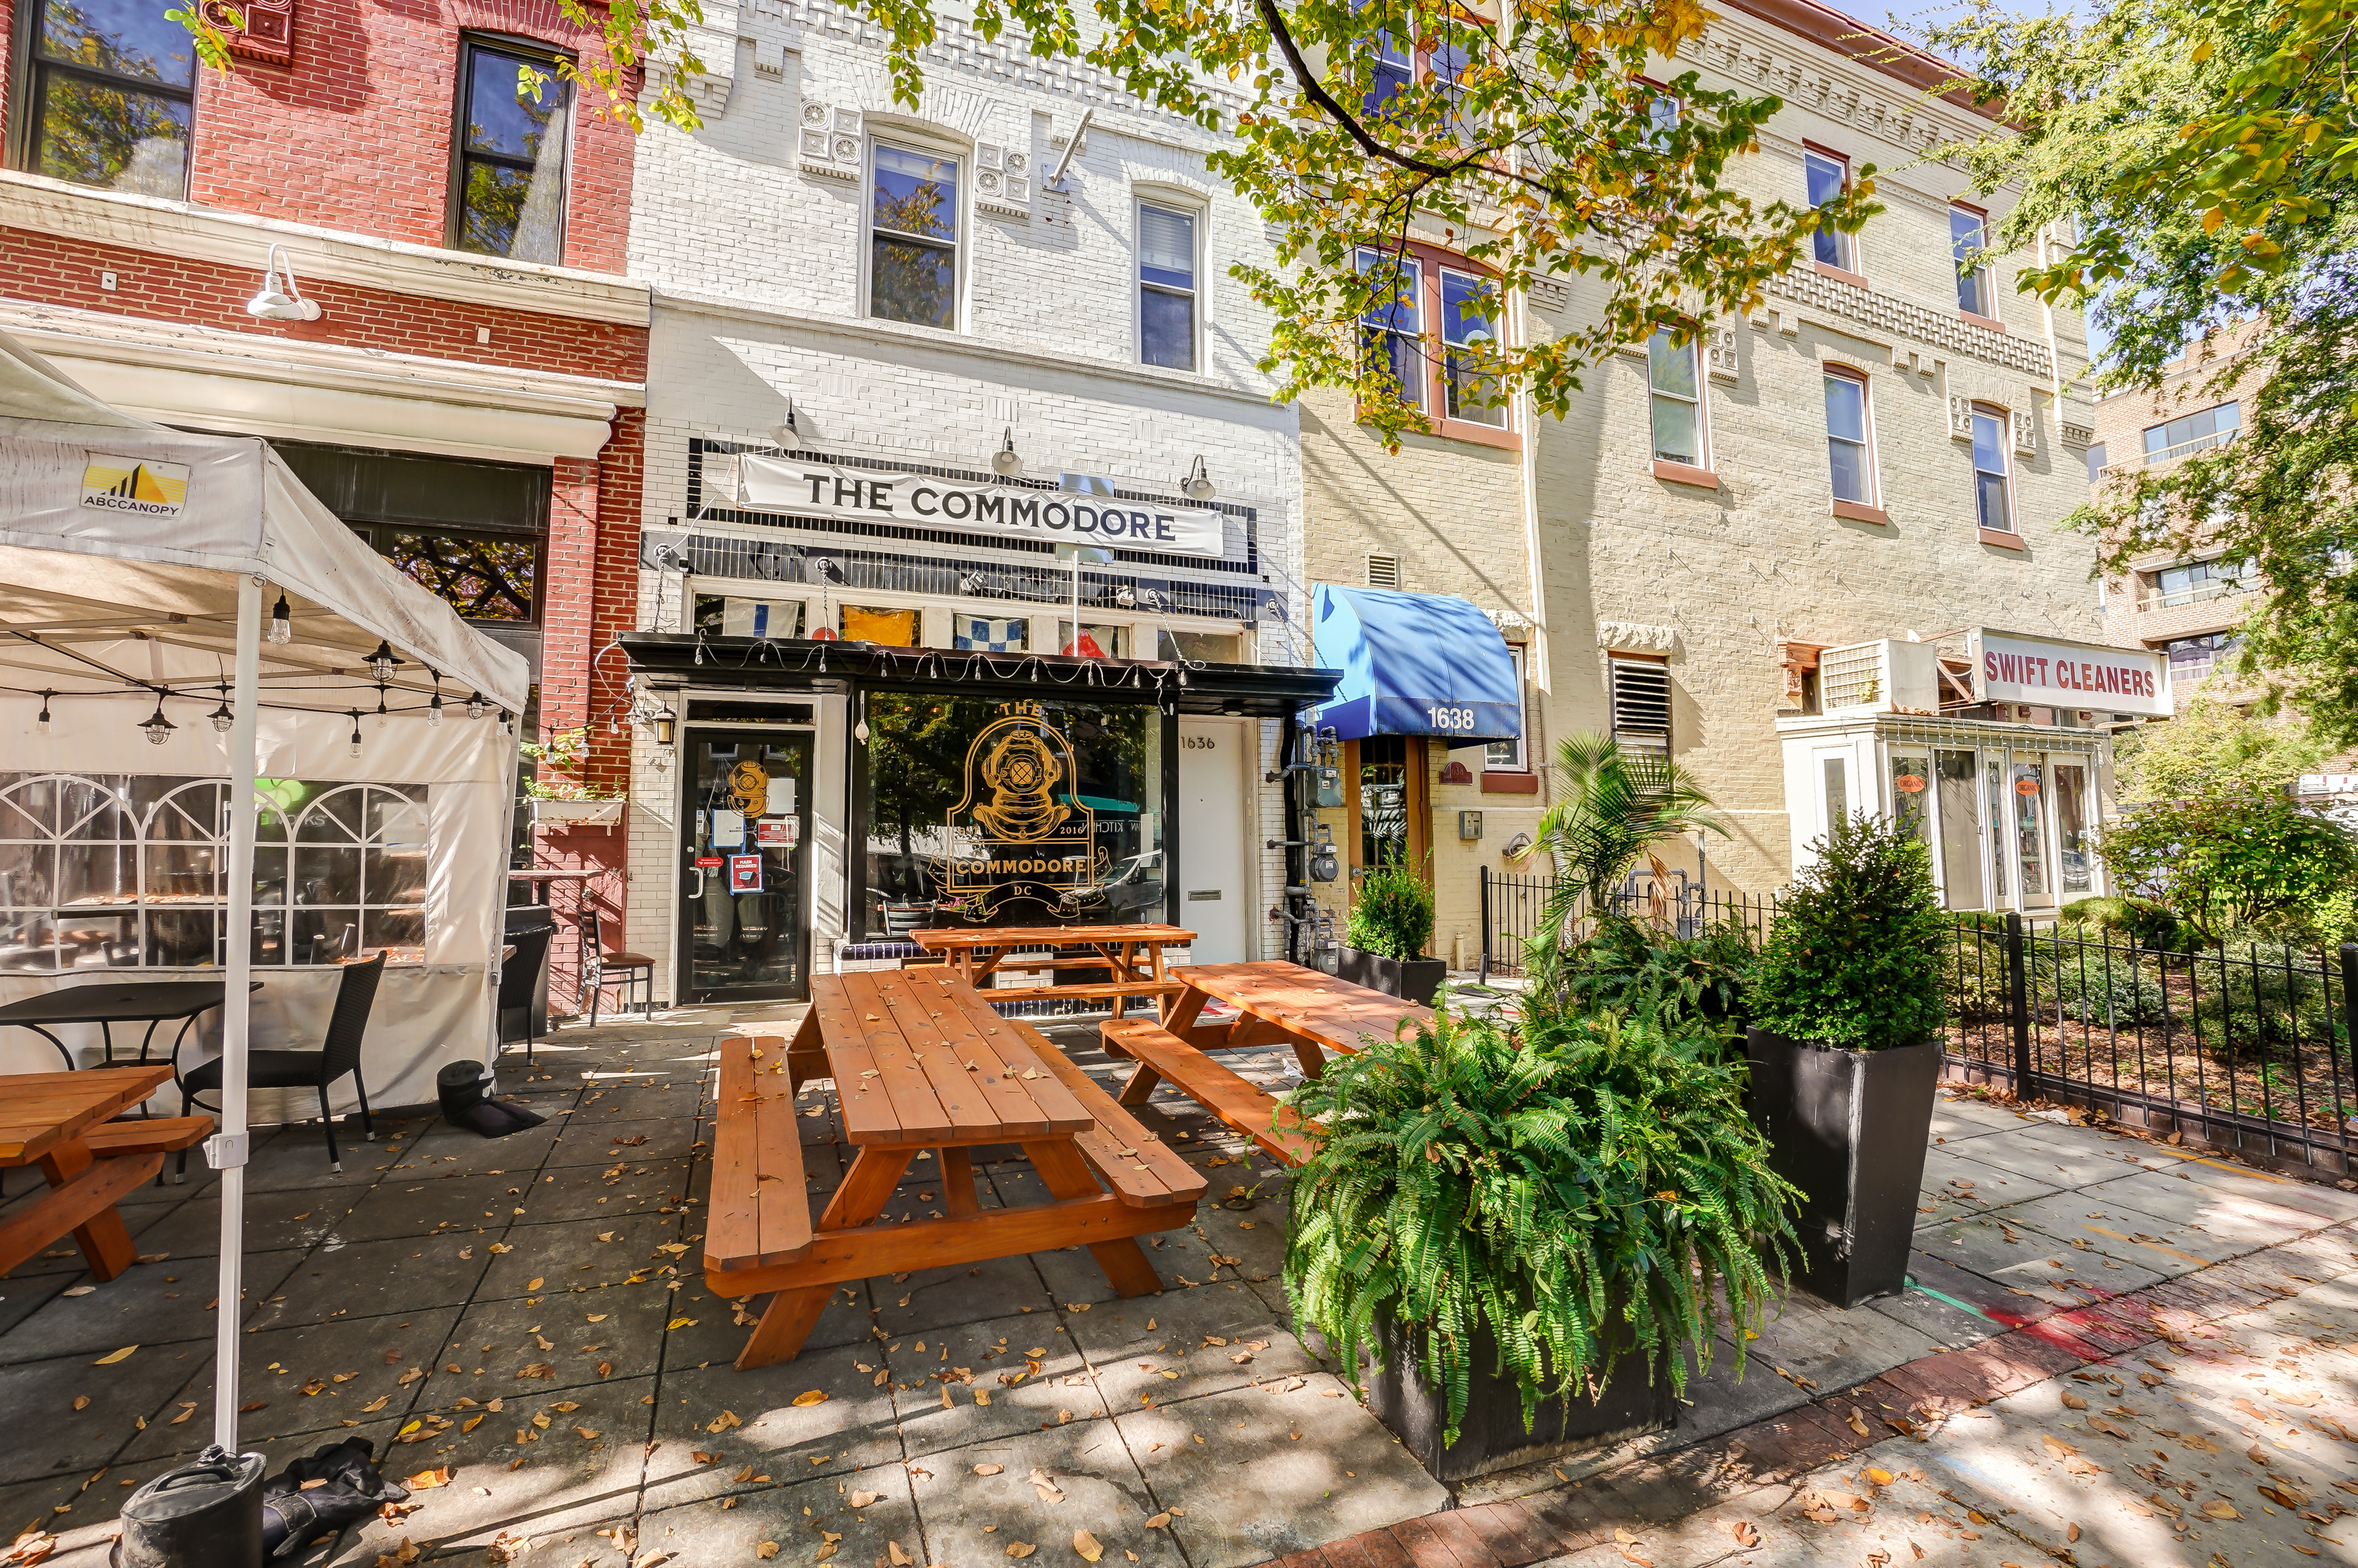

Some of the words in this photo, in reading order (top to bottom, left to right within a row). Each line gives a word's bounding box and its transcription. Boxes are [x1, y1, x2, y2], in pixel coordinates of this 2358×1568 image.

[84, 496, 179, 515] ABCCANOPY
[804, 474, 893, 512] THE
[911, 487, 1176, 541] COMMODORE
[1985, 651, 2048, 686] SWIFT
[2057, 660, 2155, 698] CLEANERS
[1000, 702, 1042, 717] THE
[1428, 707, 1474, 730] 1638
[1181, 736, 1215, 749] 1636
[956, 859, 1087, 874] COMMODORE
[1015, 886, 1032, 895] DC
